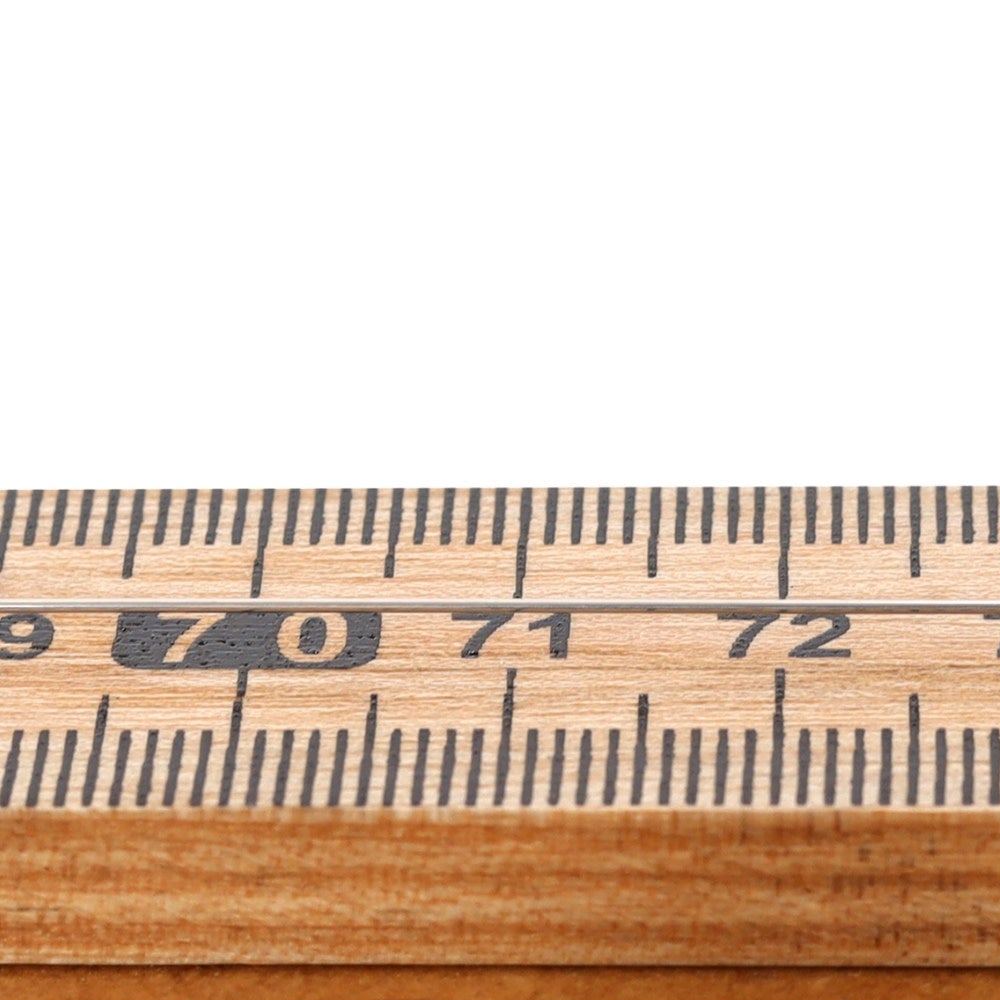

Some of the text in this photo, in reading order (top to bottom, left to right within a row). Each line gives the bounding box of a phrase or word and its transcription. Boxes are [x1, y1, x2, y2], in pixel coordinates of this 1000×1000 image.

[156, 611, 348, 663] 70
[451, 612, 571, 658] 71
[717, 612, 851, 658] 72
